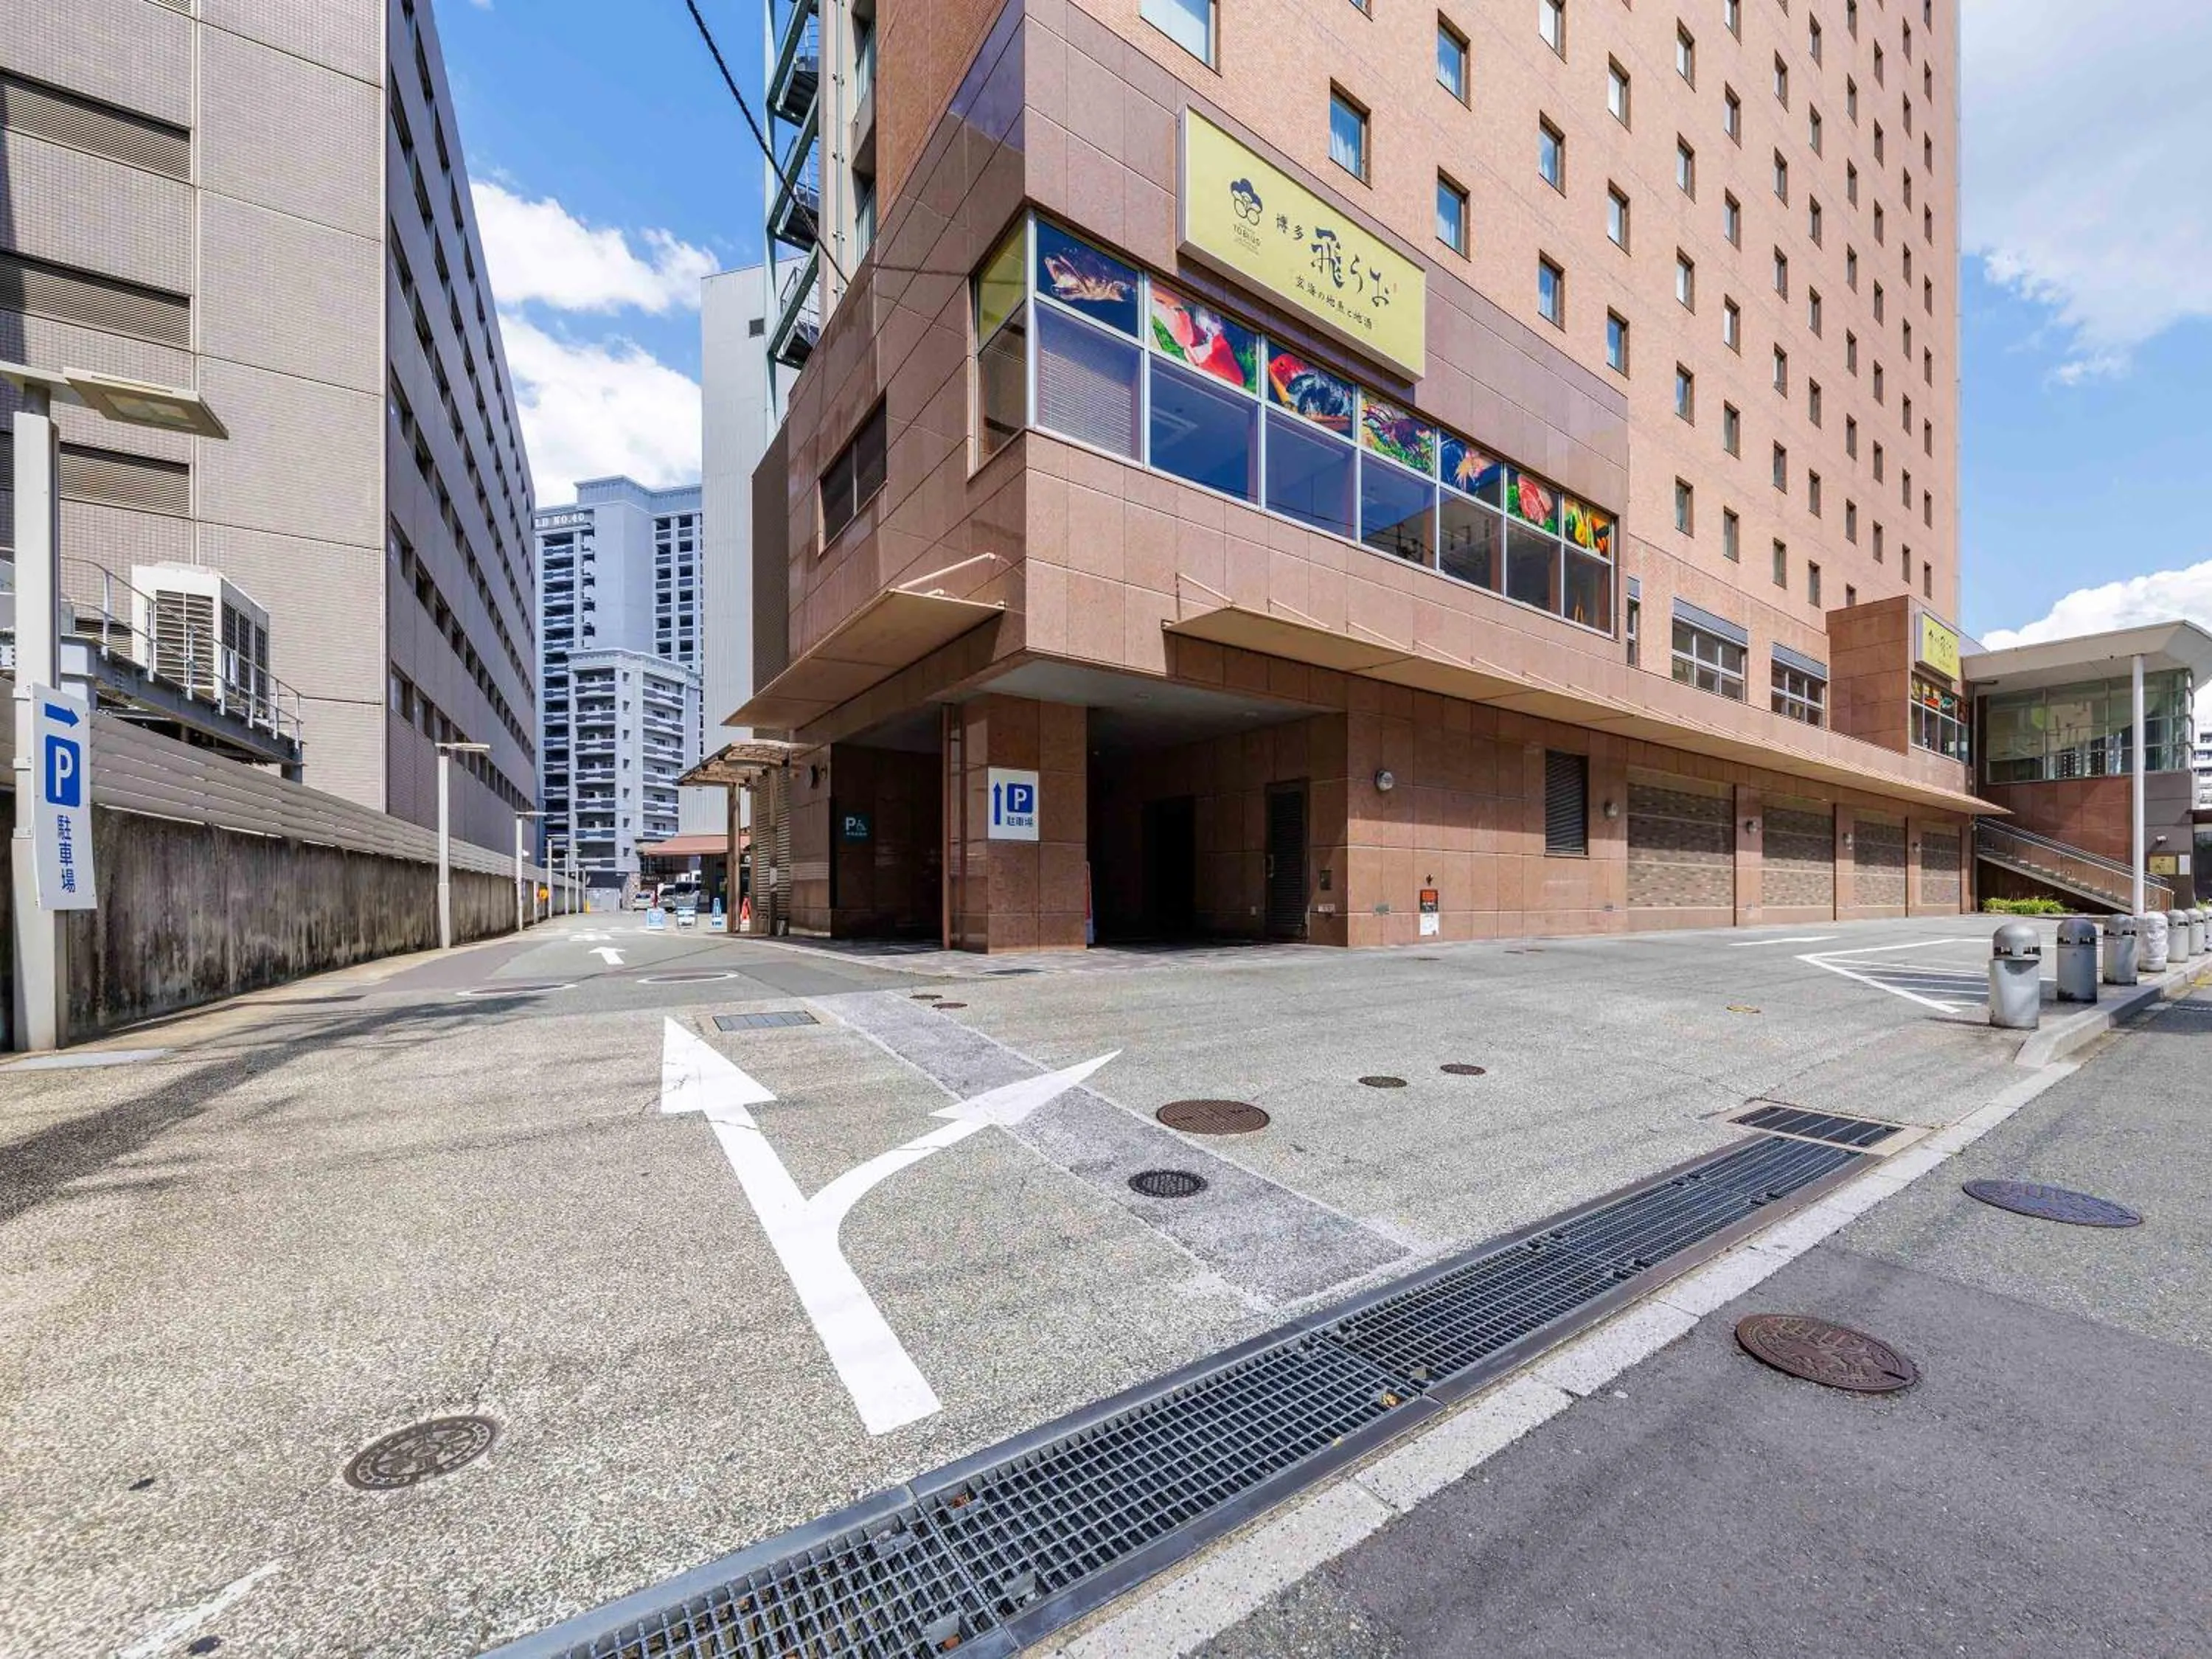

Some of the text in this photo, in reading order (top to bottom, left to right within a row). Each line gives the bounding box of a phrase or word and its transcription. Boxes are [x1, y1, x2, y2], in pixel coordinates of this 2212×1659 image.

[1276, 214, 1304, 240] 博多
[55, 745, 73, 798] P
[1014, 788, 1027, 810] P
[846, 816, 856, 831] P
[1006, 815, 1033, 827] 駐車場
[58, 814, 76, 893] 駐車場
